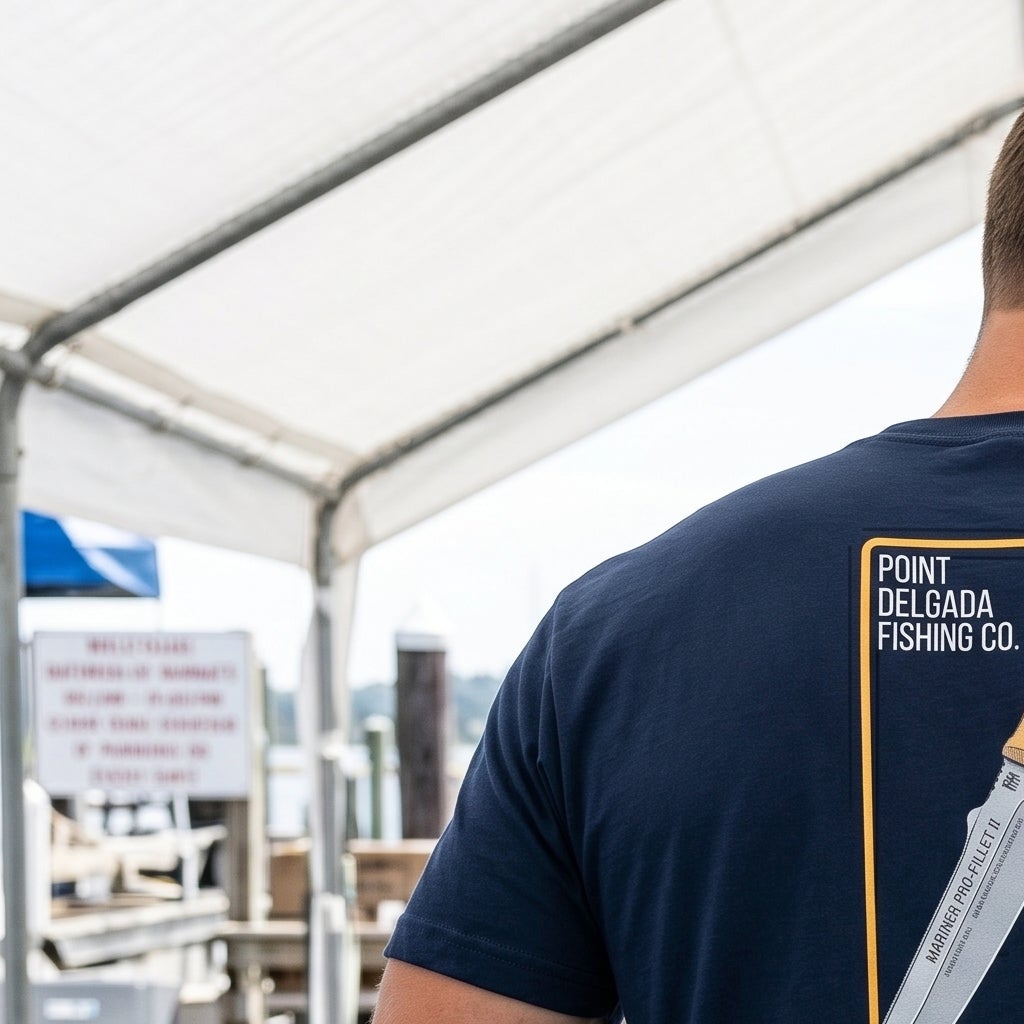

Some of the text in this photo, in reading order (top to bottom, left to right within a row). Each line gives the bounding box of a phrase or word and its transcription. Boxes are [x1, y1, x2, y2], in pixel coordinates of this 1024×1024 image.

[878, 554, 950, 584] POINT
[878, 588, 994, 618] DELGADA
[878, 622, 1020, 652] FISHING CO.
[925, 904, 962, 963] MARINER
[953, 829, 996, 905] PRO-FILLET
